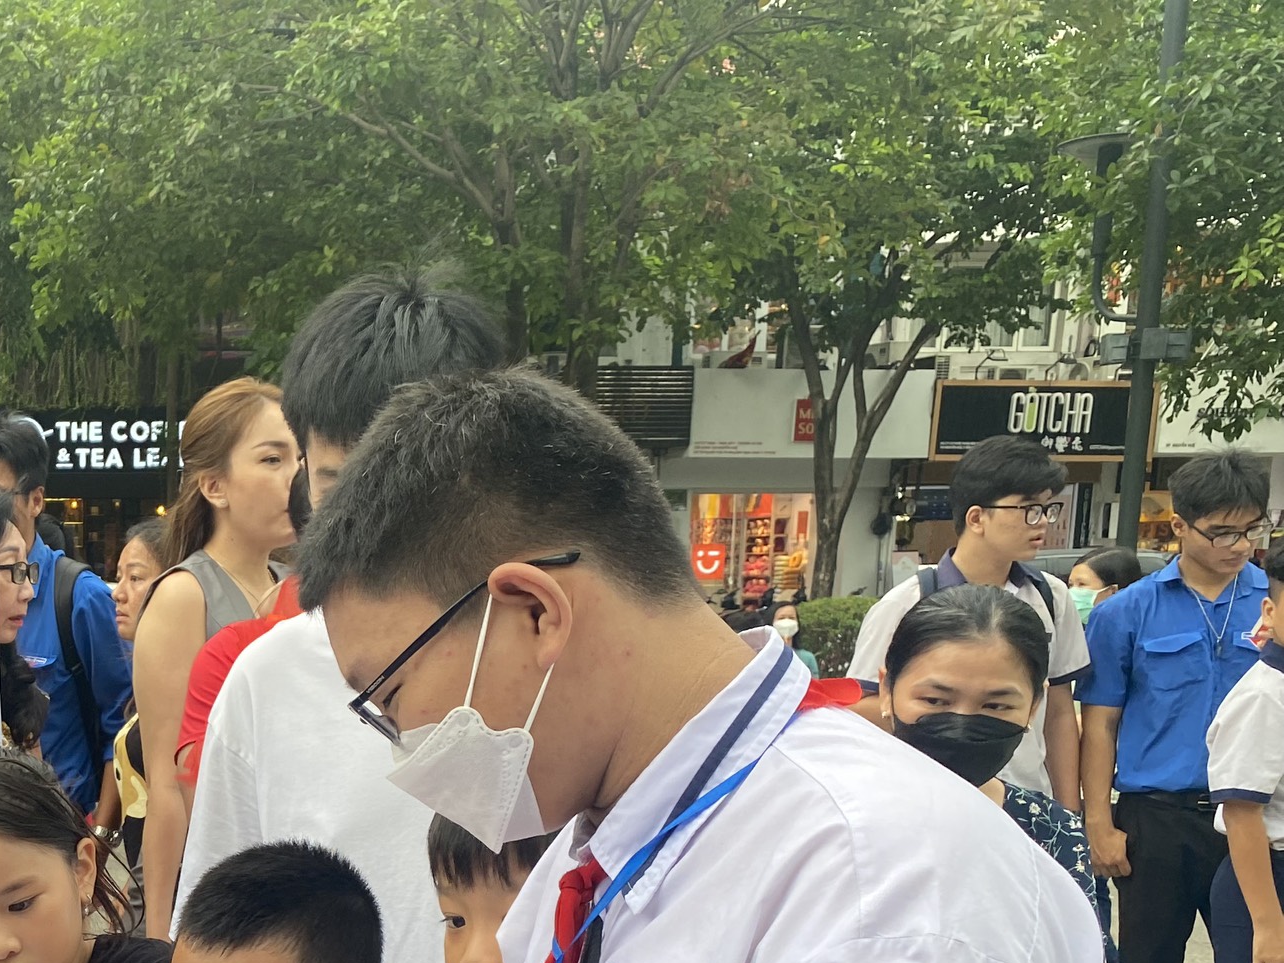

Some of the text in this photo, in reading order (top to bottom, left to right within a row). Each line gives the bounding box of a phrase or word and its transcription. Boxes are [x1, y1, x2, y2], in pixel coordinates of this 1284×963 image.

[1007, 390, 1094, 434] GOTCHA
[55, 420, 103, 443] THE
[75, 447, 124, 469] TEA
